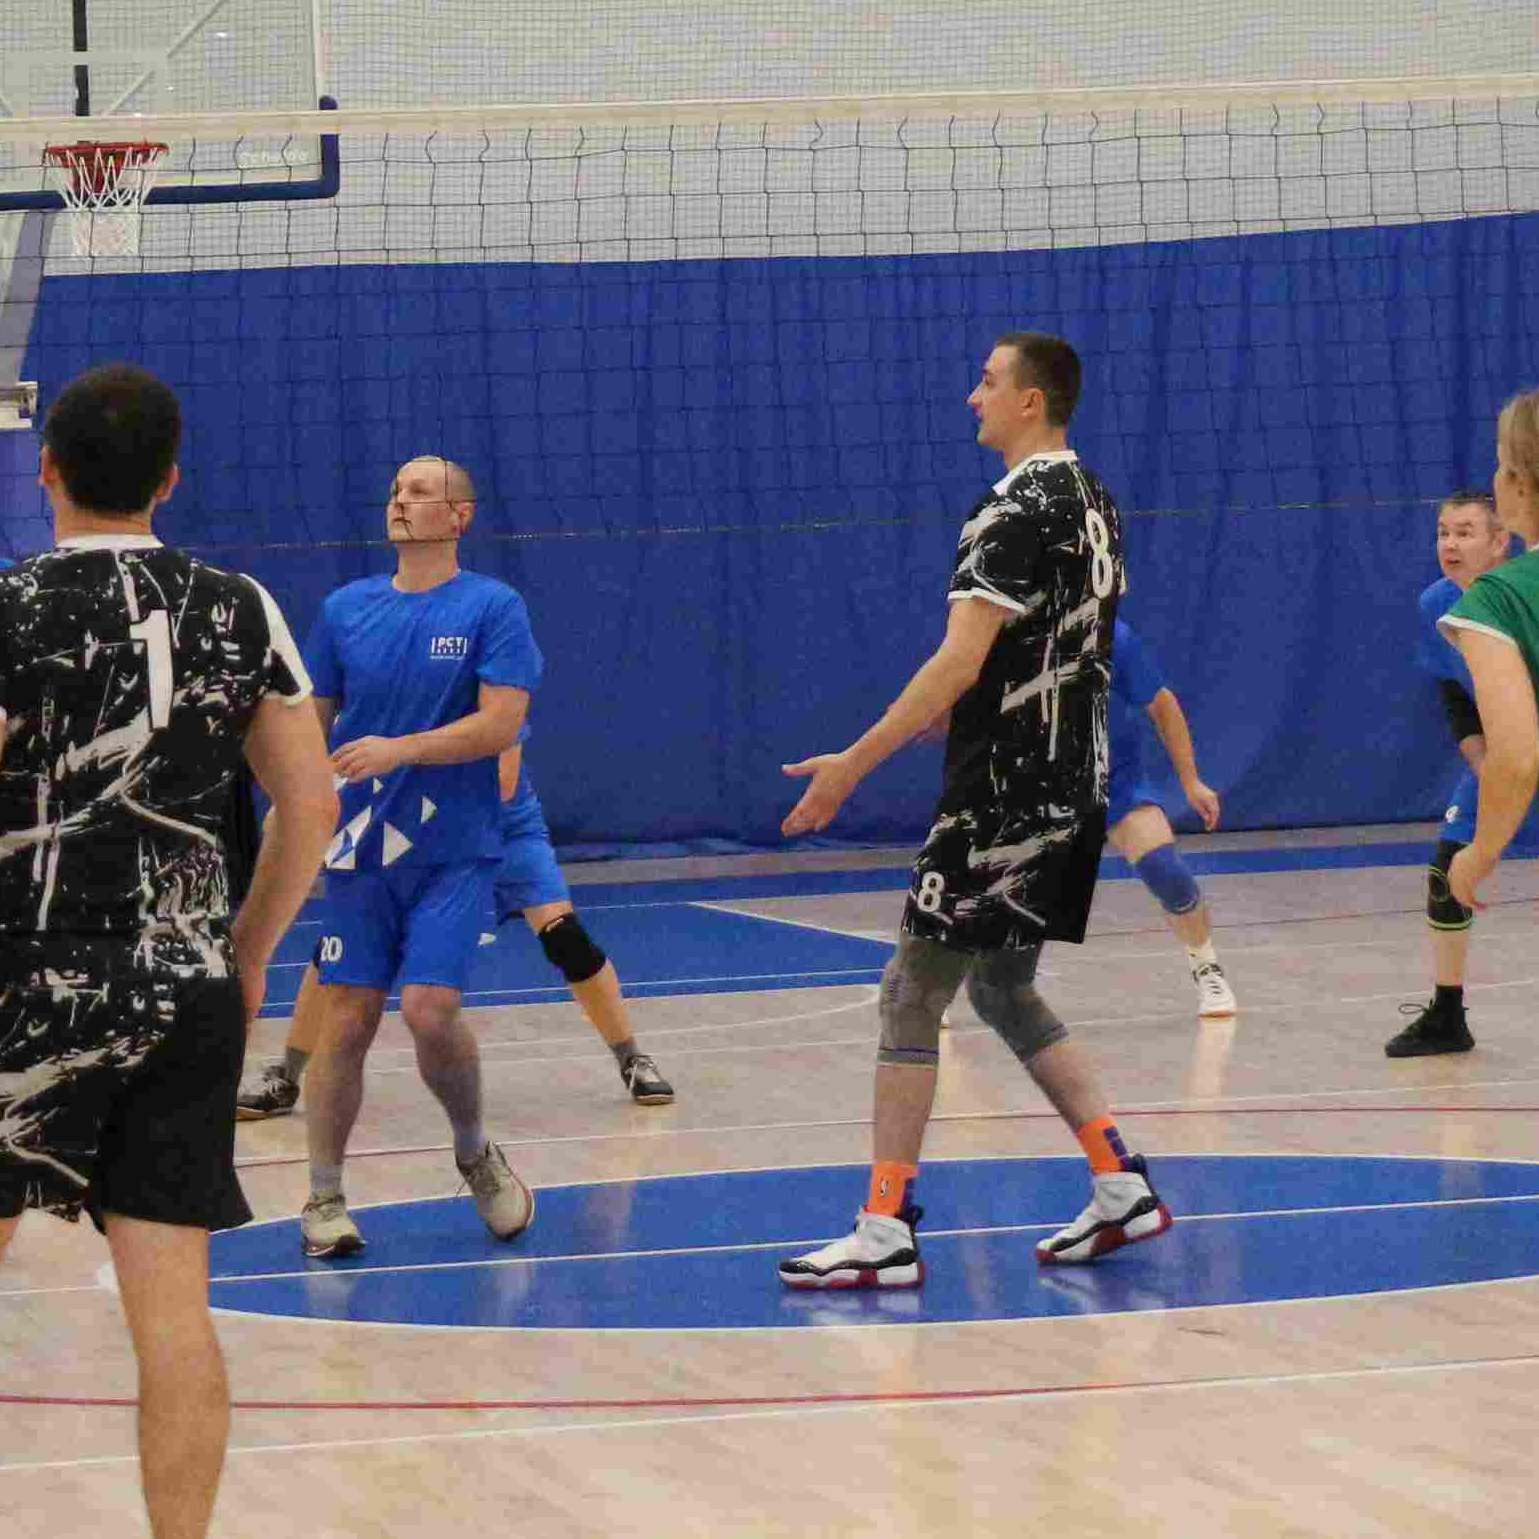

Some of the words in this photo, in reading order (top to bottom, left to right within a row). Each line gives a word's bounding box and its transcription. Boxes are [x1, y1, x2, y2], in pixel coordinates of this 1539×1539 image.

[1084, 508, 1114, 599] 8
[129, 609, 174, 728] 1
[917, 871, 945, 912] 8
